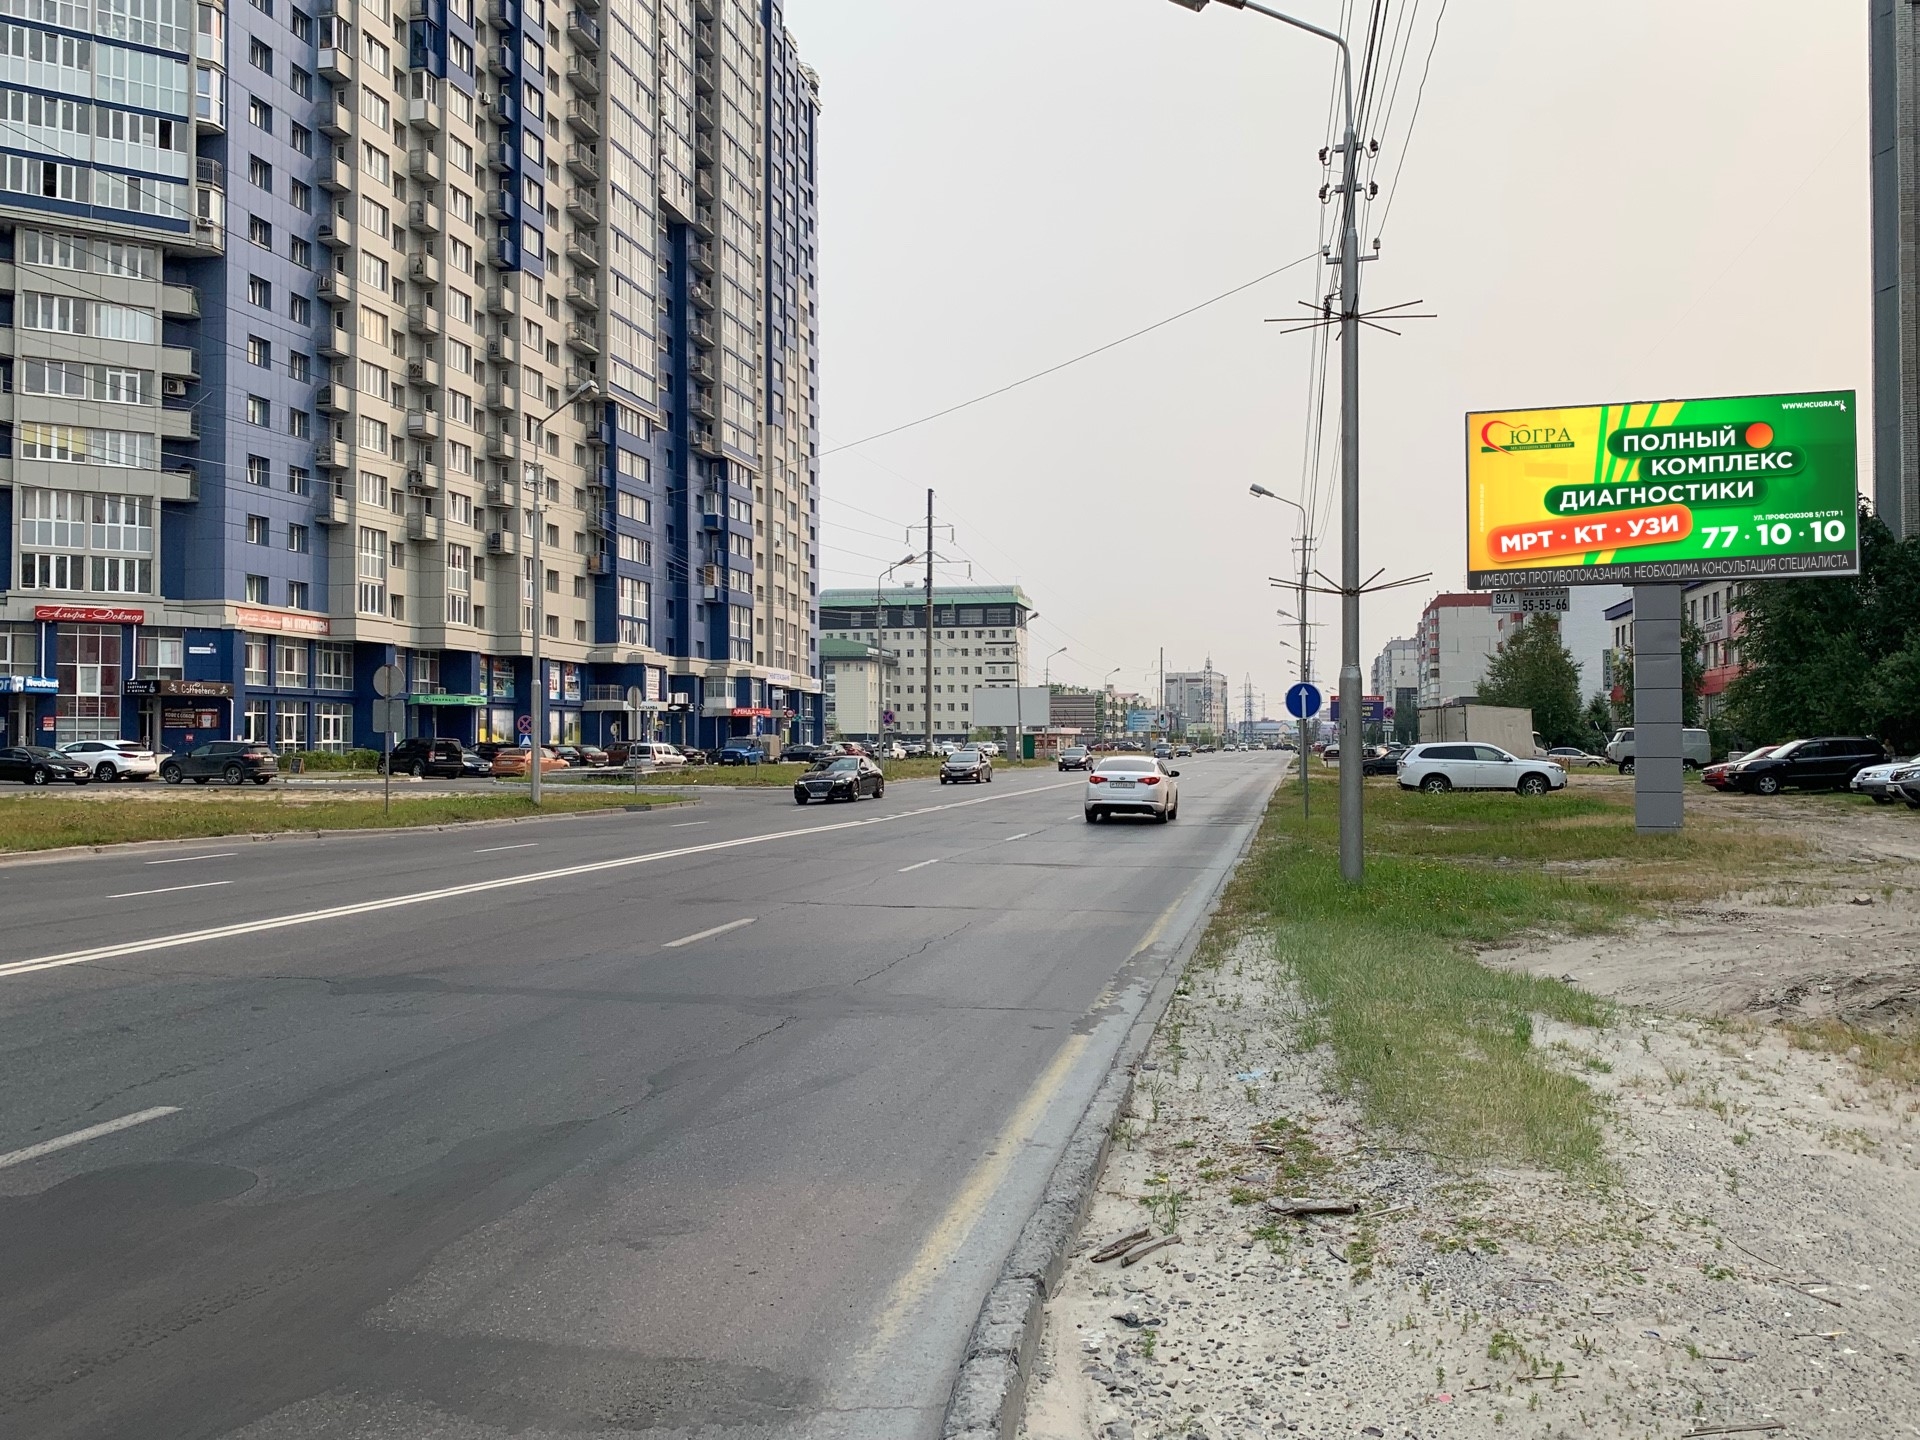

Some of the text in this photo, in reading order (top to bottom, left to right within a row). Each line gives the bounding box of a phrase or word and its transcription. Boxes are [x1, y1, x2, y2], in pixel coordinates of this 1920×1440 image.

[1510, 427, 1571, 445] ЮГРА
[1623, 425, 1736, 452] ПОЛНЫЙ
[1651, 451, 1793, 476] КОМПЛЕКС
[1559, 481, 1754, 512] ДИАГНОСТИКИ
[1765, 511, 1813, 521] ПРОФСОЮЗОВ
[1814, 510, 1825, 519] 5/1
[1500, 515, 1679, 553] МРТ КТ УЗИ
[1480, 554, 1849, 587] ИМЕЮТСЯ ПРОТИВОПОКАЗАНИЯ. НЕОБХОДИМА КОНСУЛЬТАЦИЯ СПЕЦИАЛИСТА
[1522, 599, 1567, 611] 55-55-66
[25, 678, 60, 688] NeoDent
